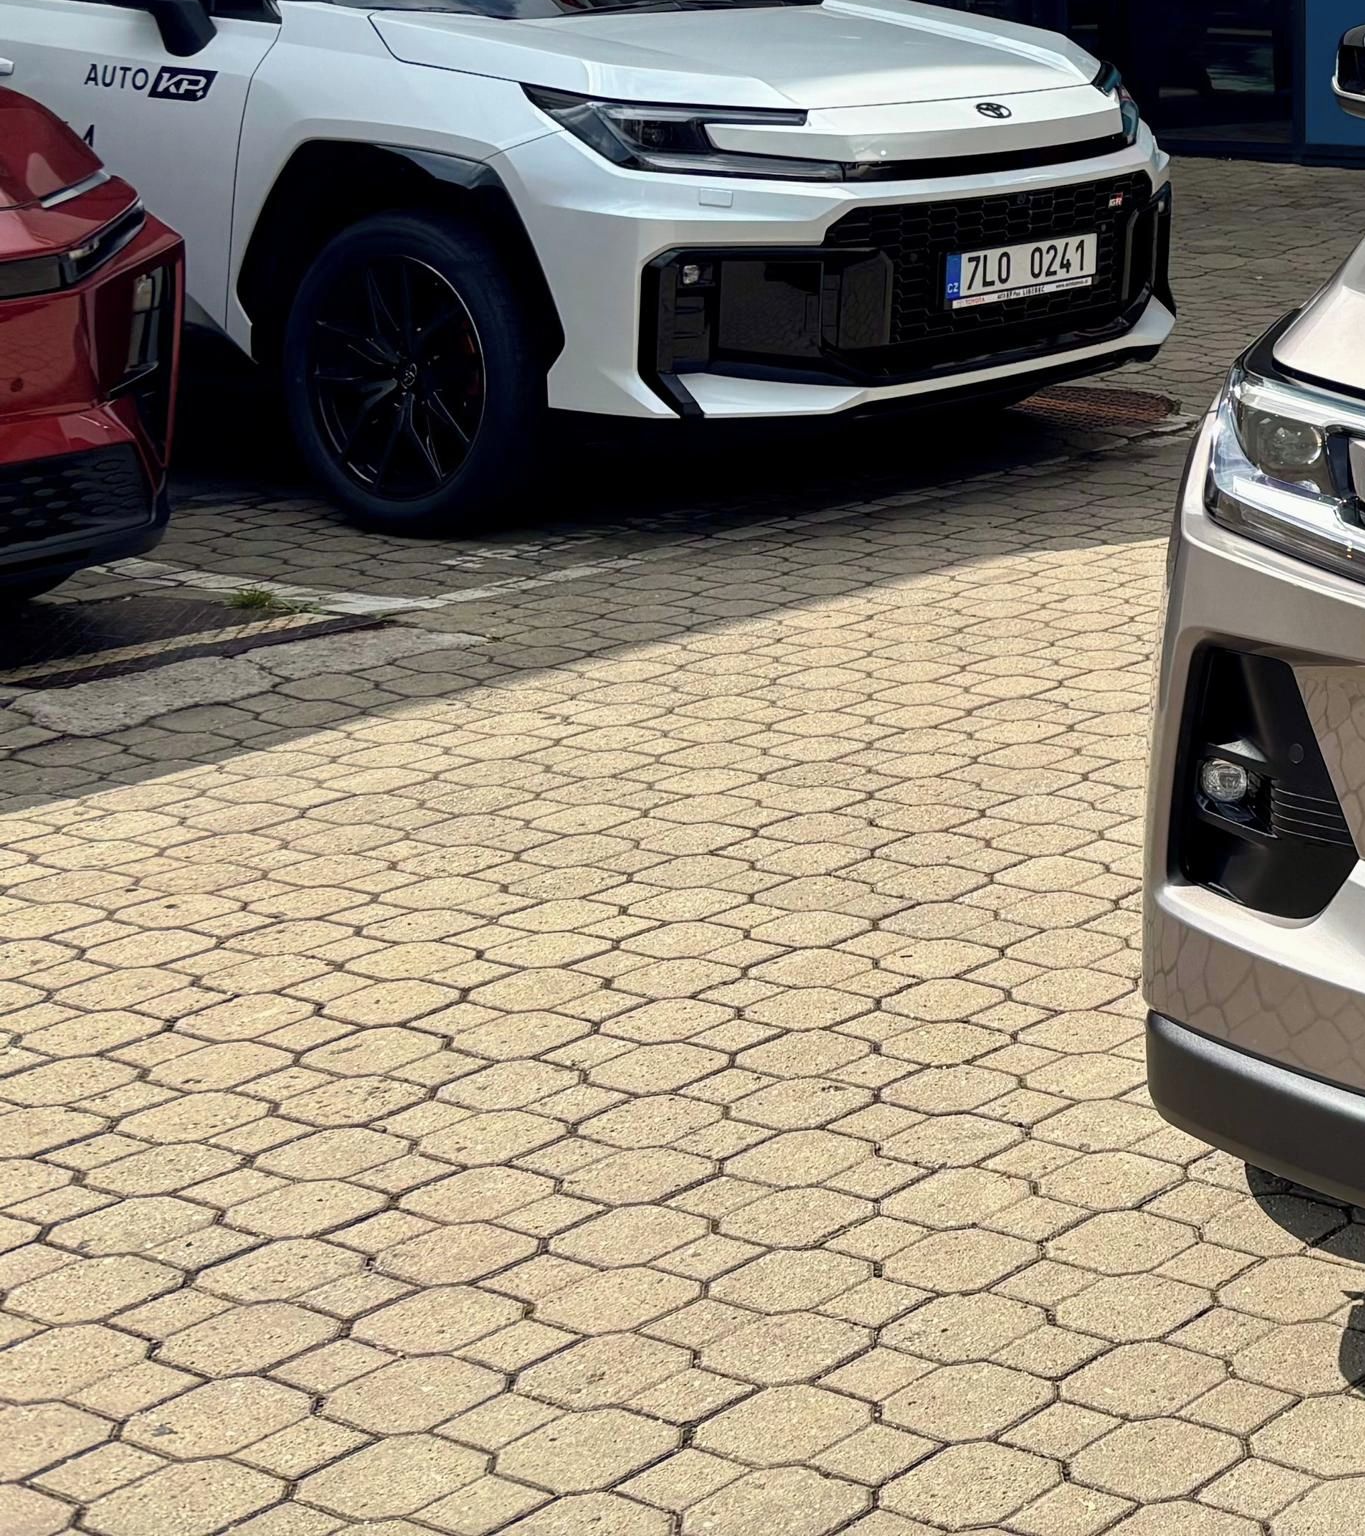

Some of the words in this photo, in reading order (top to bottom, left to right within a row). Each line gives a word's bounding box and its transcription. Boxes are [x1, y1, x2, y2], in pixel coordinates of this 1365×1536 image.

[84, 64, 149, 91] AUTO
[1030, 239, 1085, 279] 0241
[947, 282, 960, 294] CZ
